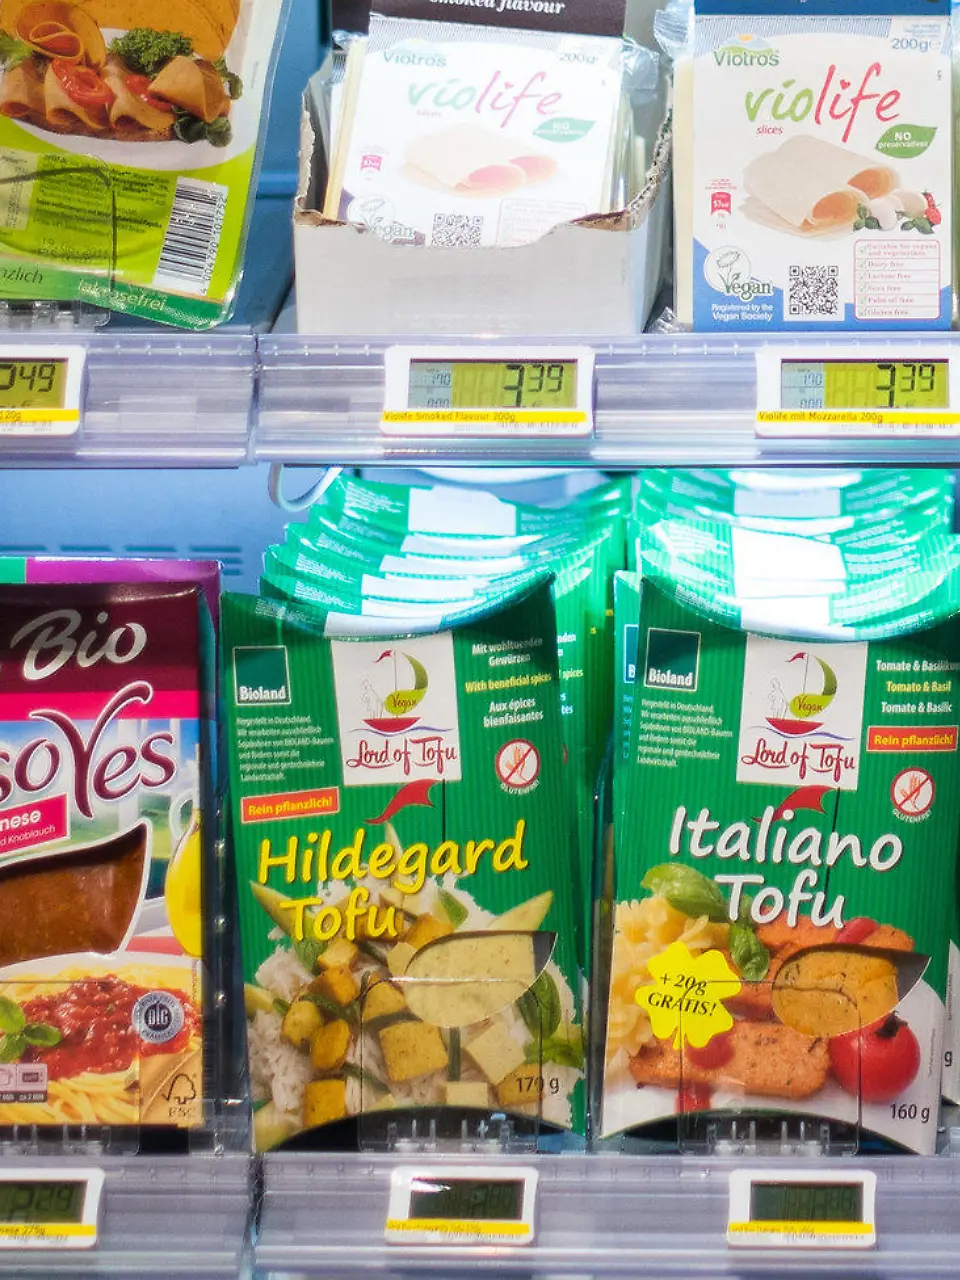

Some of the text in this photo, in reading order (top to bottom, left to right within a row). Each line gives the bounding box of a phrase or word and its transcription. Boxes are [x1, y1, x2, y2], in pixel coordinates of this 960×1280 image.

[714, 51, 780, 67] Viotros
[407, 70, 563, 128] violife
[745, 62, 901, 143] violife
[894, 132, 912, 140] NO
[718, 273, 772, 300] Vegan
[10, 609, 148, 681] Bio
[472, 643, 488, 656] Mit
[876, 660, 911, 672] Tomate
[912, 660, 920, 672] &
[465, 673, 552, 693] With beneficial spices
[648, 667, 693, 686] Bioland
[239, 686, 287, 701] Bioland
[886, 680, 952, 693] Tomato & Basil
[391, 694, 417, 710] Vegan
[489, 698, 536, 713] Aux épices
[794, 695, 823, 713] Vegan
[881, 701, 953, 713] Tomate & Basilic
[483, 710, 544, 728] bienfaisantes
[874, 734, 954, 748] Rein pflanzlich!
[346, 740, 391, 769] Lord
[393, 739, 410, 774] of
[410, 737, 458, 774] Tofu
[741, 738, 855, 781] Lord of Tofu
[248, 796, 333, 817] Rein pflanzlich!
[668, 805, 903, 871] Italiano
[257, 818, 529, 894] Hildegard
[714, 868, 844, 930] Tofu
[279, 887, 399, 942] Tofu
[676, 973, 708, 997] 20g
[648, 992, 718, 1018] GRATIS!
[549, 1078, 560, 1094] g
[890, 1103, 930, 1122] 160 g
